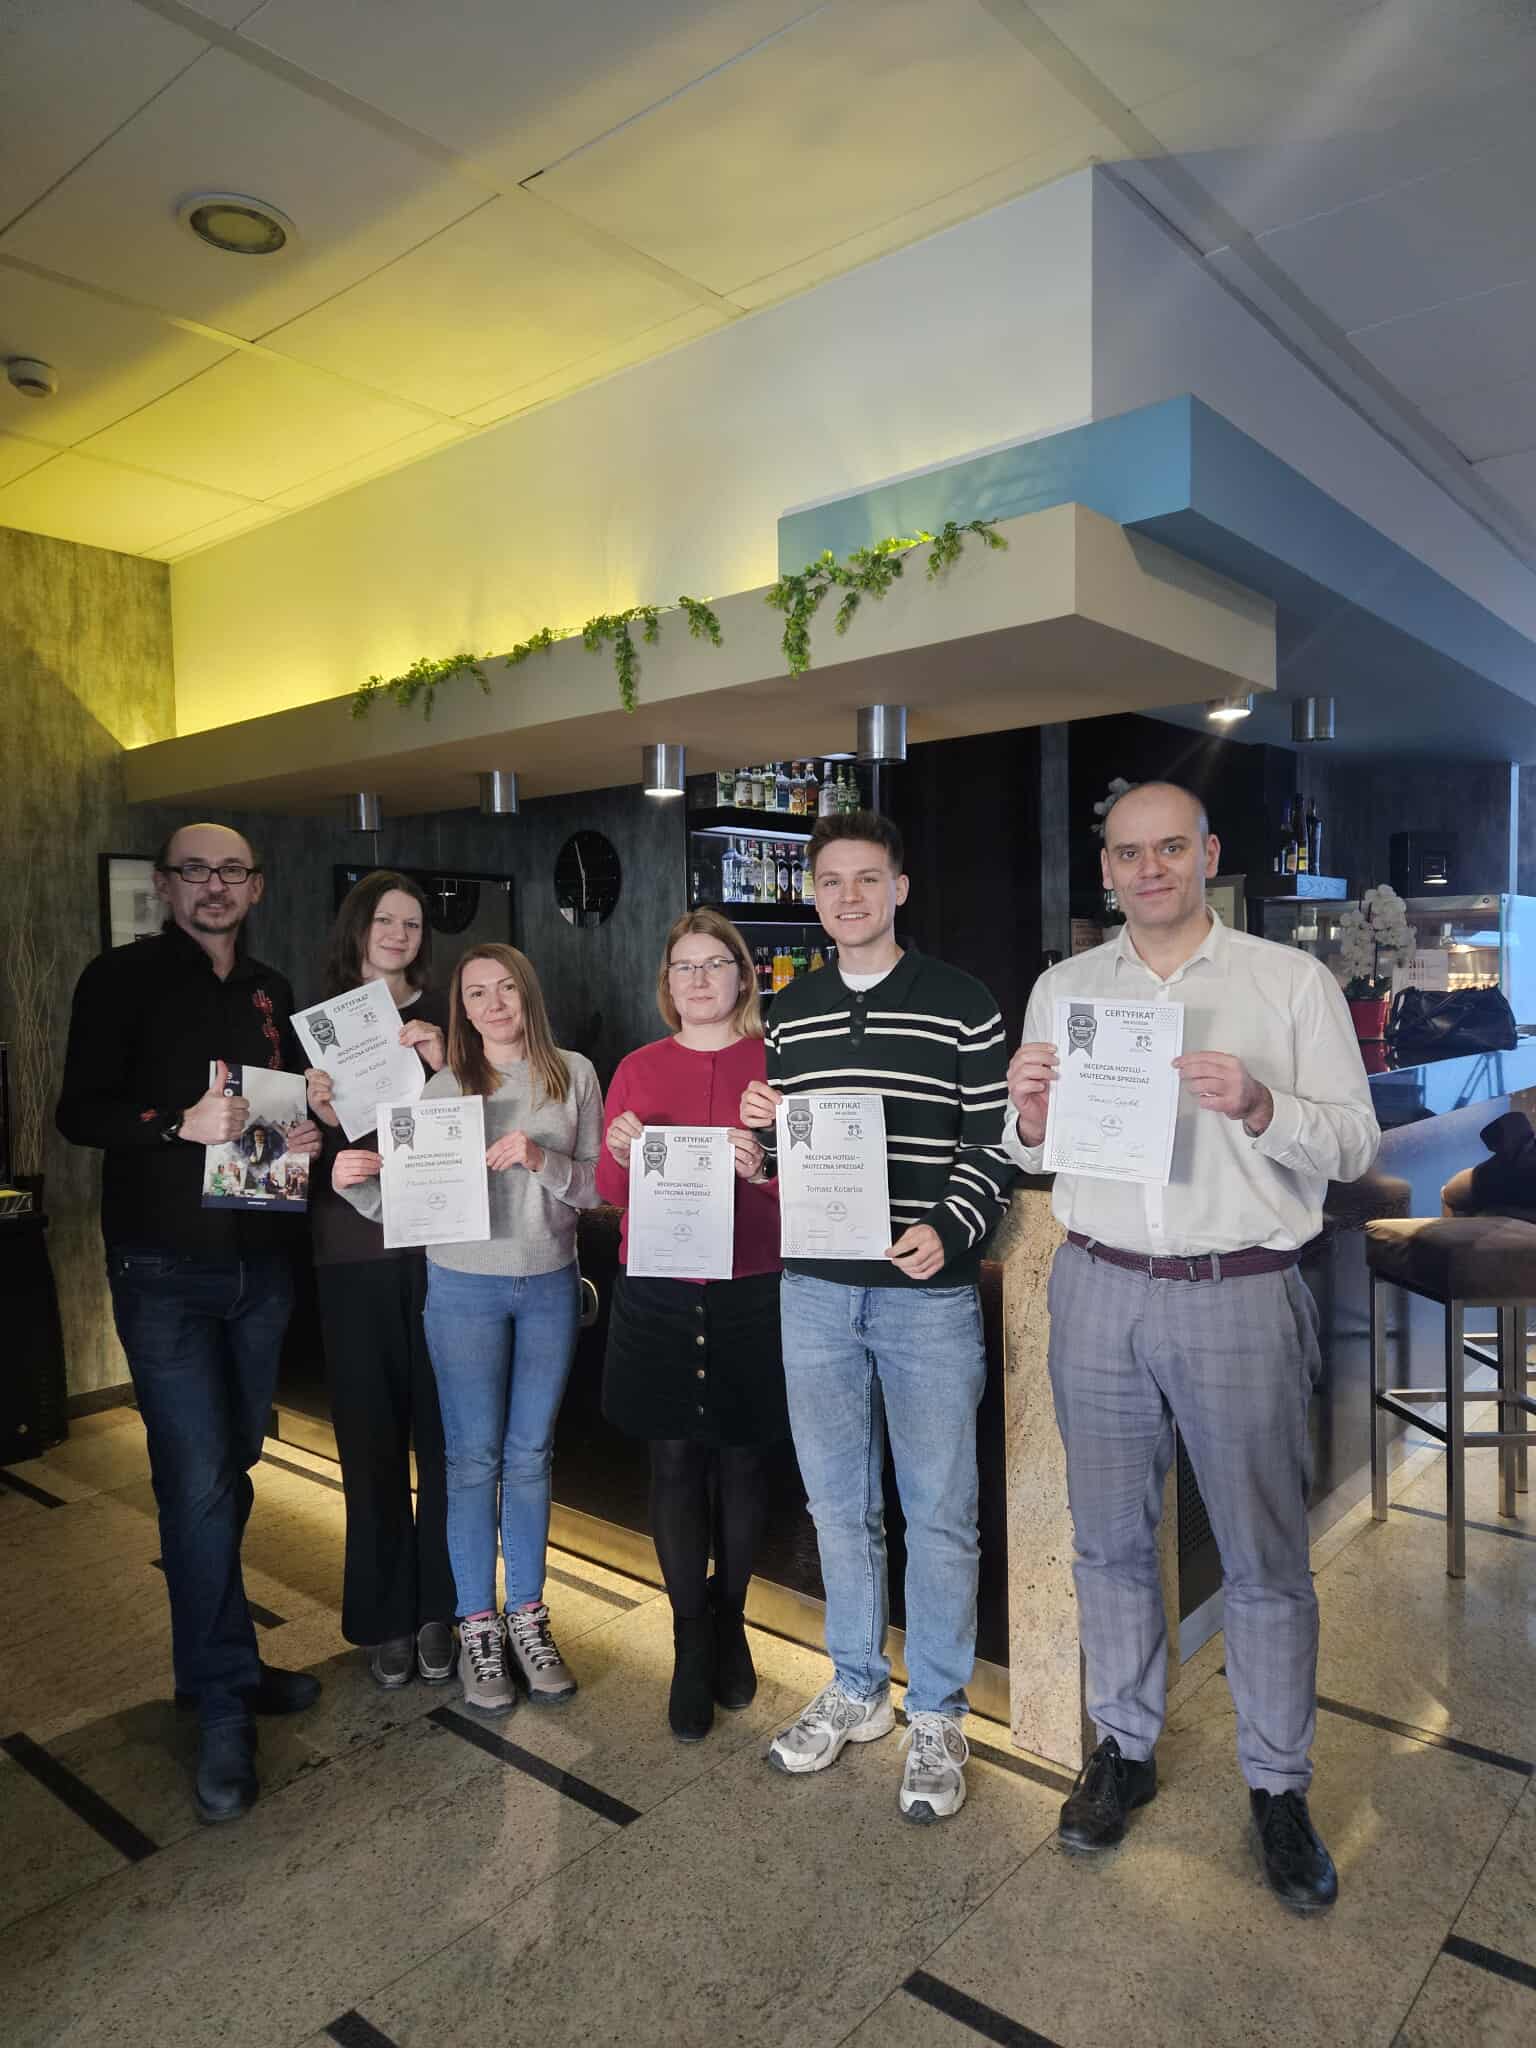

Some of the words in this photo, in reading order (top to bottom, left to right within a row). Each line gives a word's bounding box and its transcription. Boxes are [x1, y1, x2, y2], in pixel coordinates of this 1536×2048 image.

[1104, 1009, 1155, 1020] CERTYFIKAT
[819, 1102, 862, 1110] CERTYFIKAT
[673, 1136, 713, 1144] CERTYFIKAT
